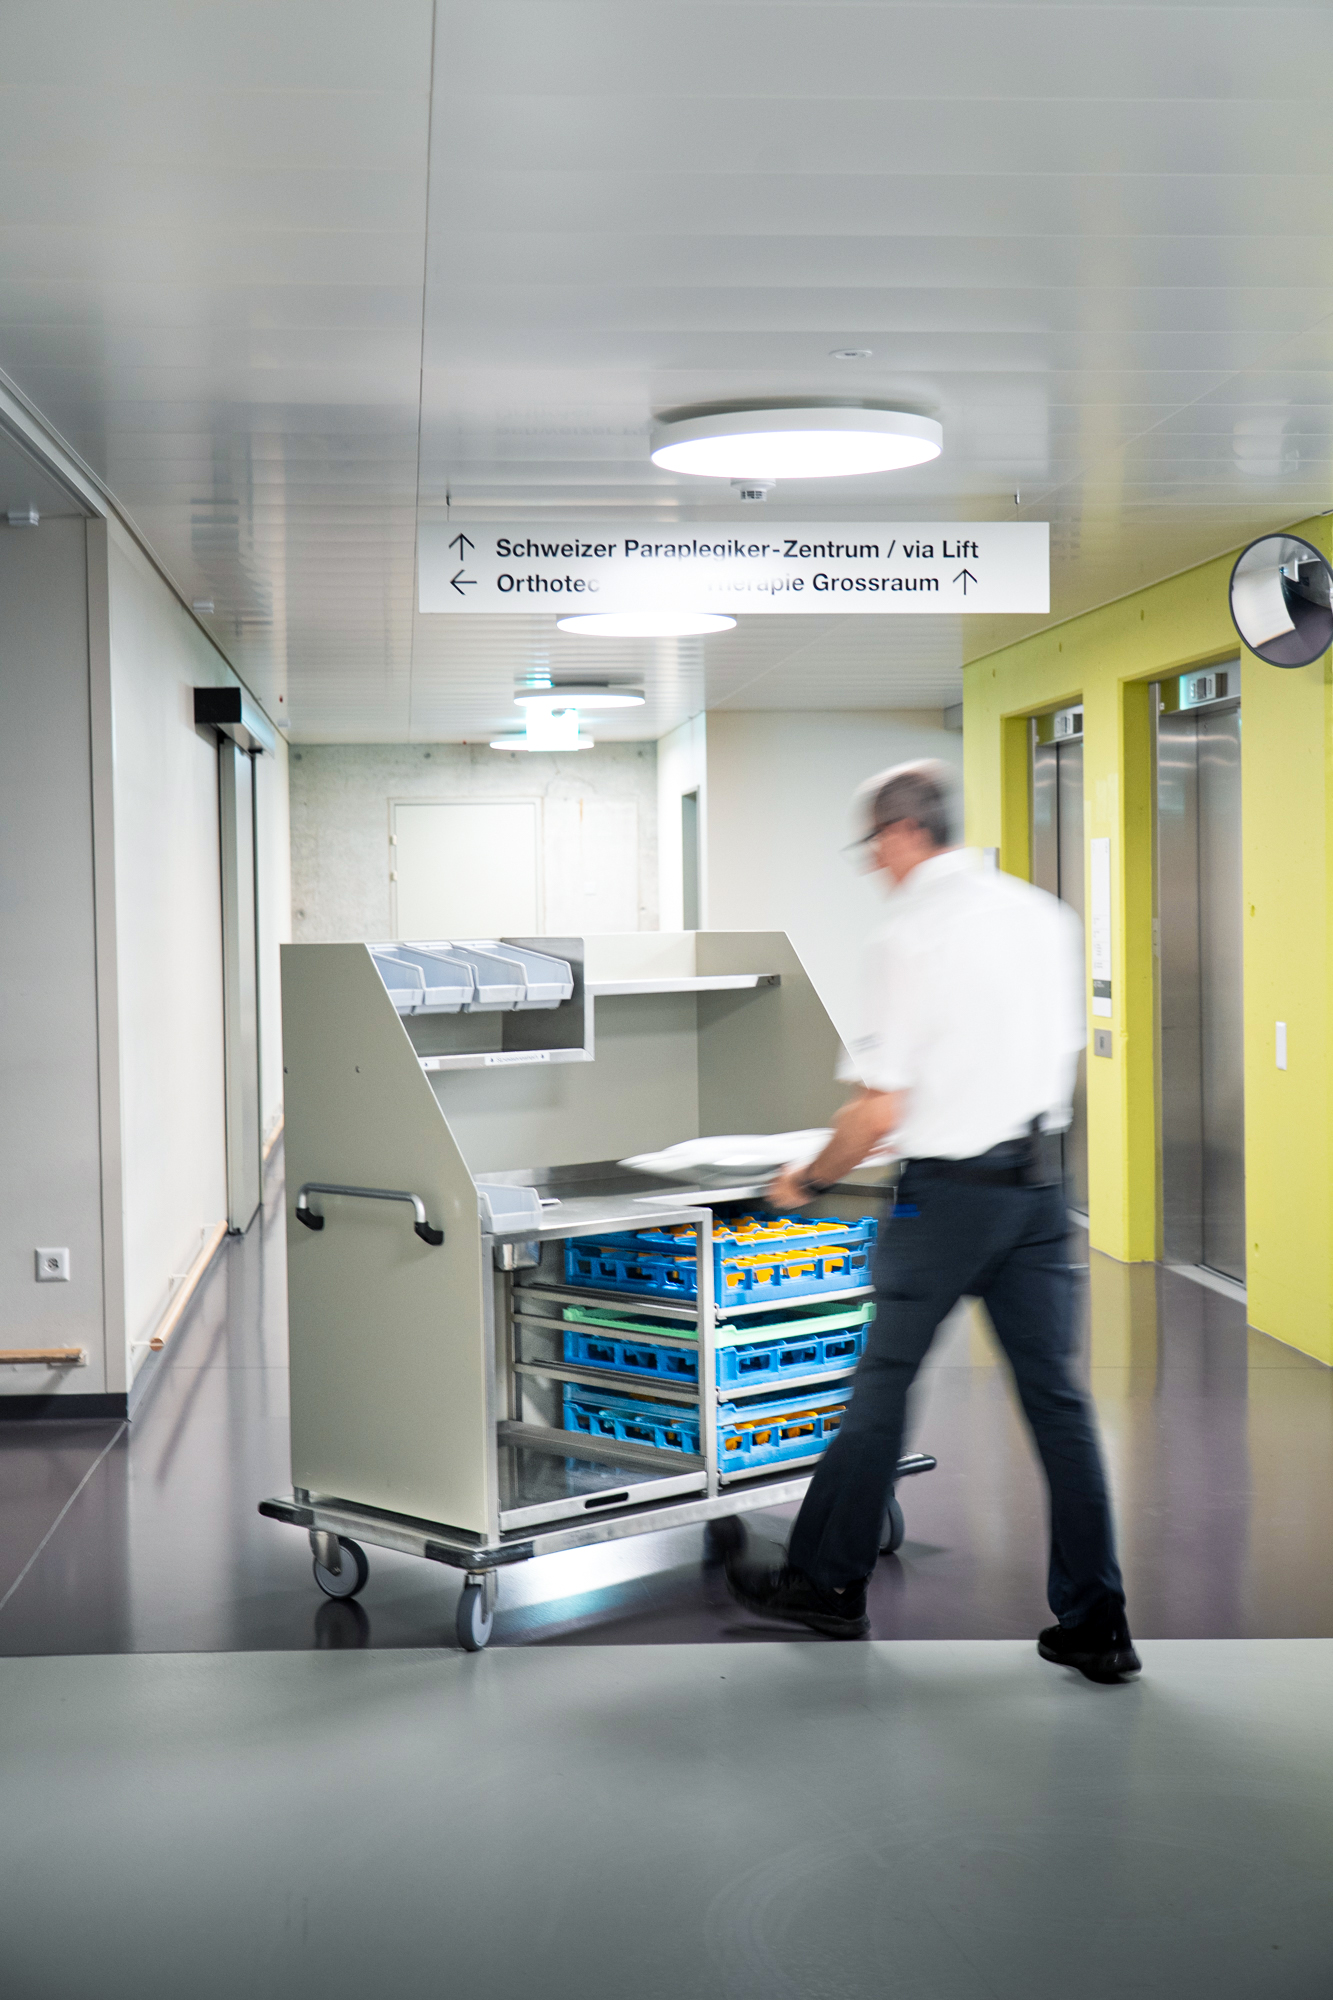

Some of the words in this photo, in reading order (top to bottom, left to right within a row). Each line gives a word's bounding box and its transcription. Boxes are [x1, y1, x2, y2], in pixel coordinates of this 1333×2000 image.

[496, 539, 617, 558] Schweizer
[625, 539, 880, 563] Paraplegiker-Zentrum
[886, 539, 897, 558] /
[902, 539, 935, 558] via
[942, 538, 980, 558] Lift
[812, 572, 940, 592] Grossraum
